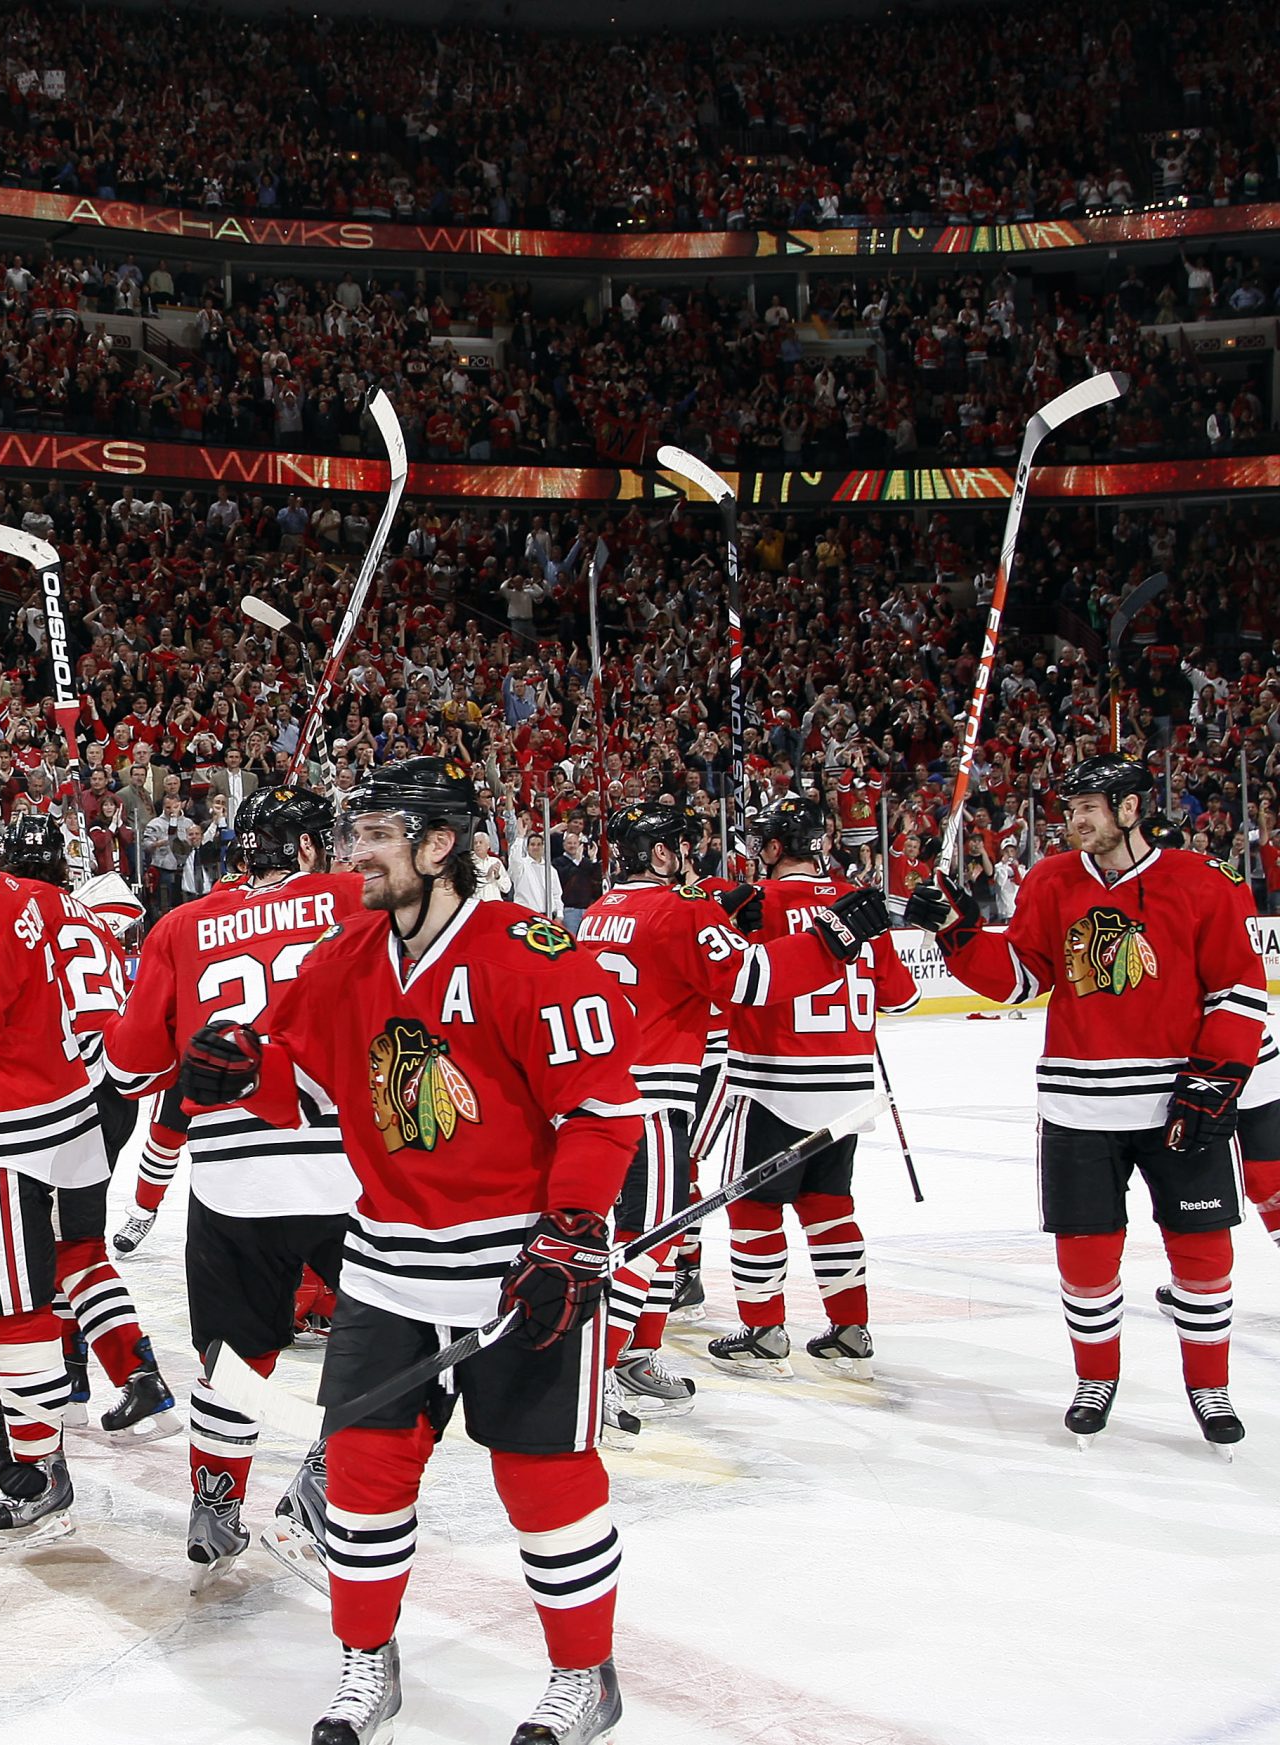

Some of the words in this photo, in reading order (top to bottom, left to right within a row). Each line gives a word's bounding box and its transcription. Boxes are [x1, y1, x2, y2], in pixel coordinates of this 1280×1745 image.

[42, 571, 74, 703] TORSPO
[958, 609, 1001, 774] EASTON
[731, 684, 745, 832] EASTON
[25, 832, 44, 845] 24
[241, 832, 257, 849] 22
[197, 891, 336, 951] BROUWER
[576, 915, 636, 944] OLLAND
[697, 923, 750, 962] 36
[895, 948, 916, 963] AK
[441, 965, 476, 1024] A
[539, 994, 616, 1067] 10
[1180, 1198, 1222, 1211] Reebok
